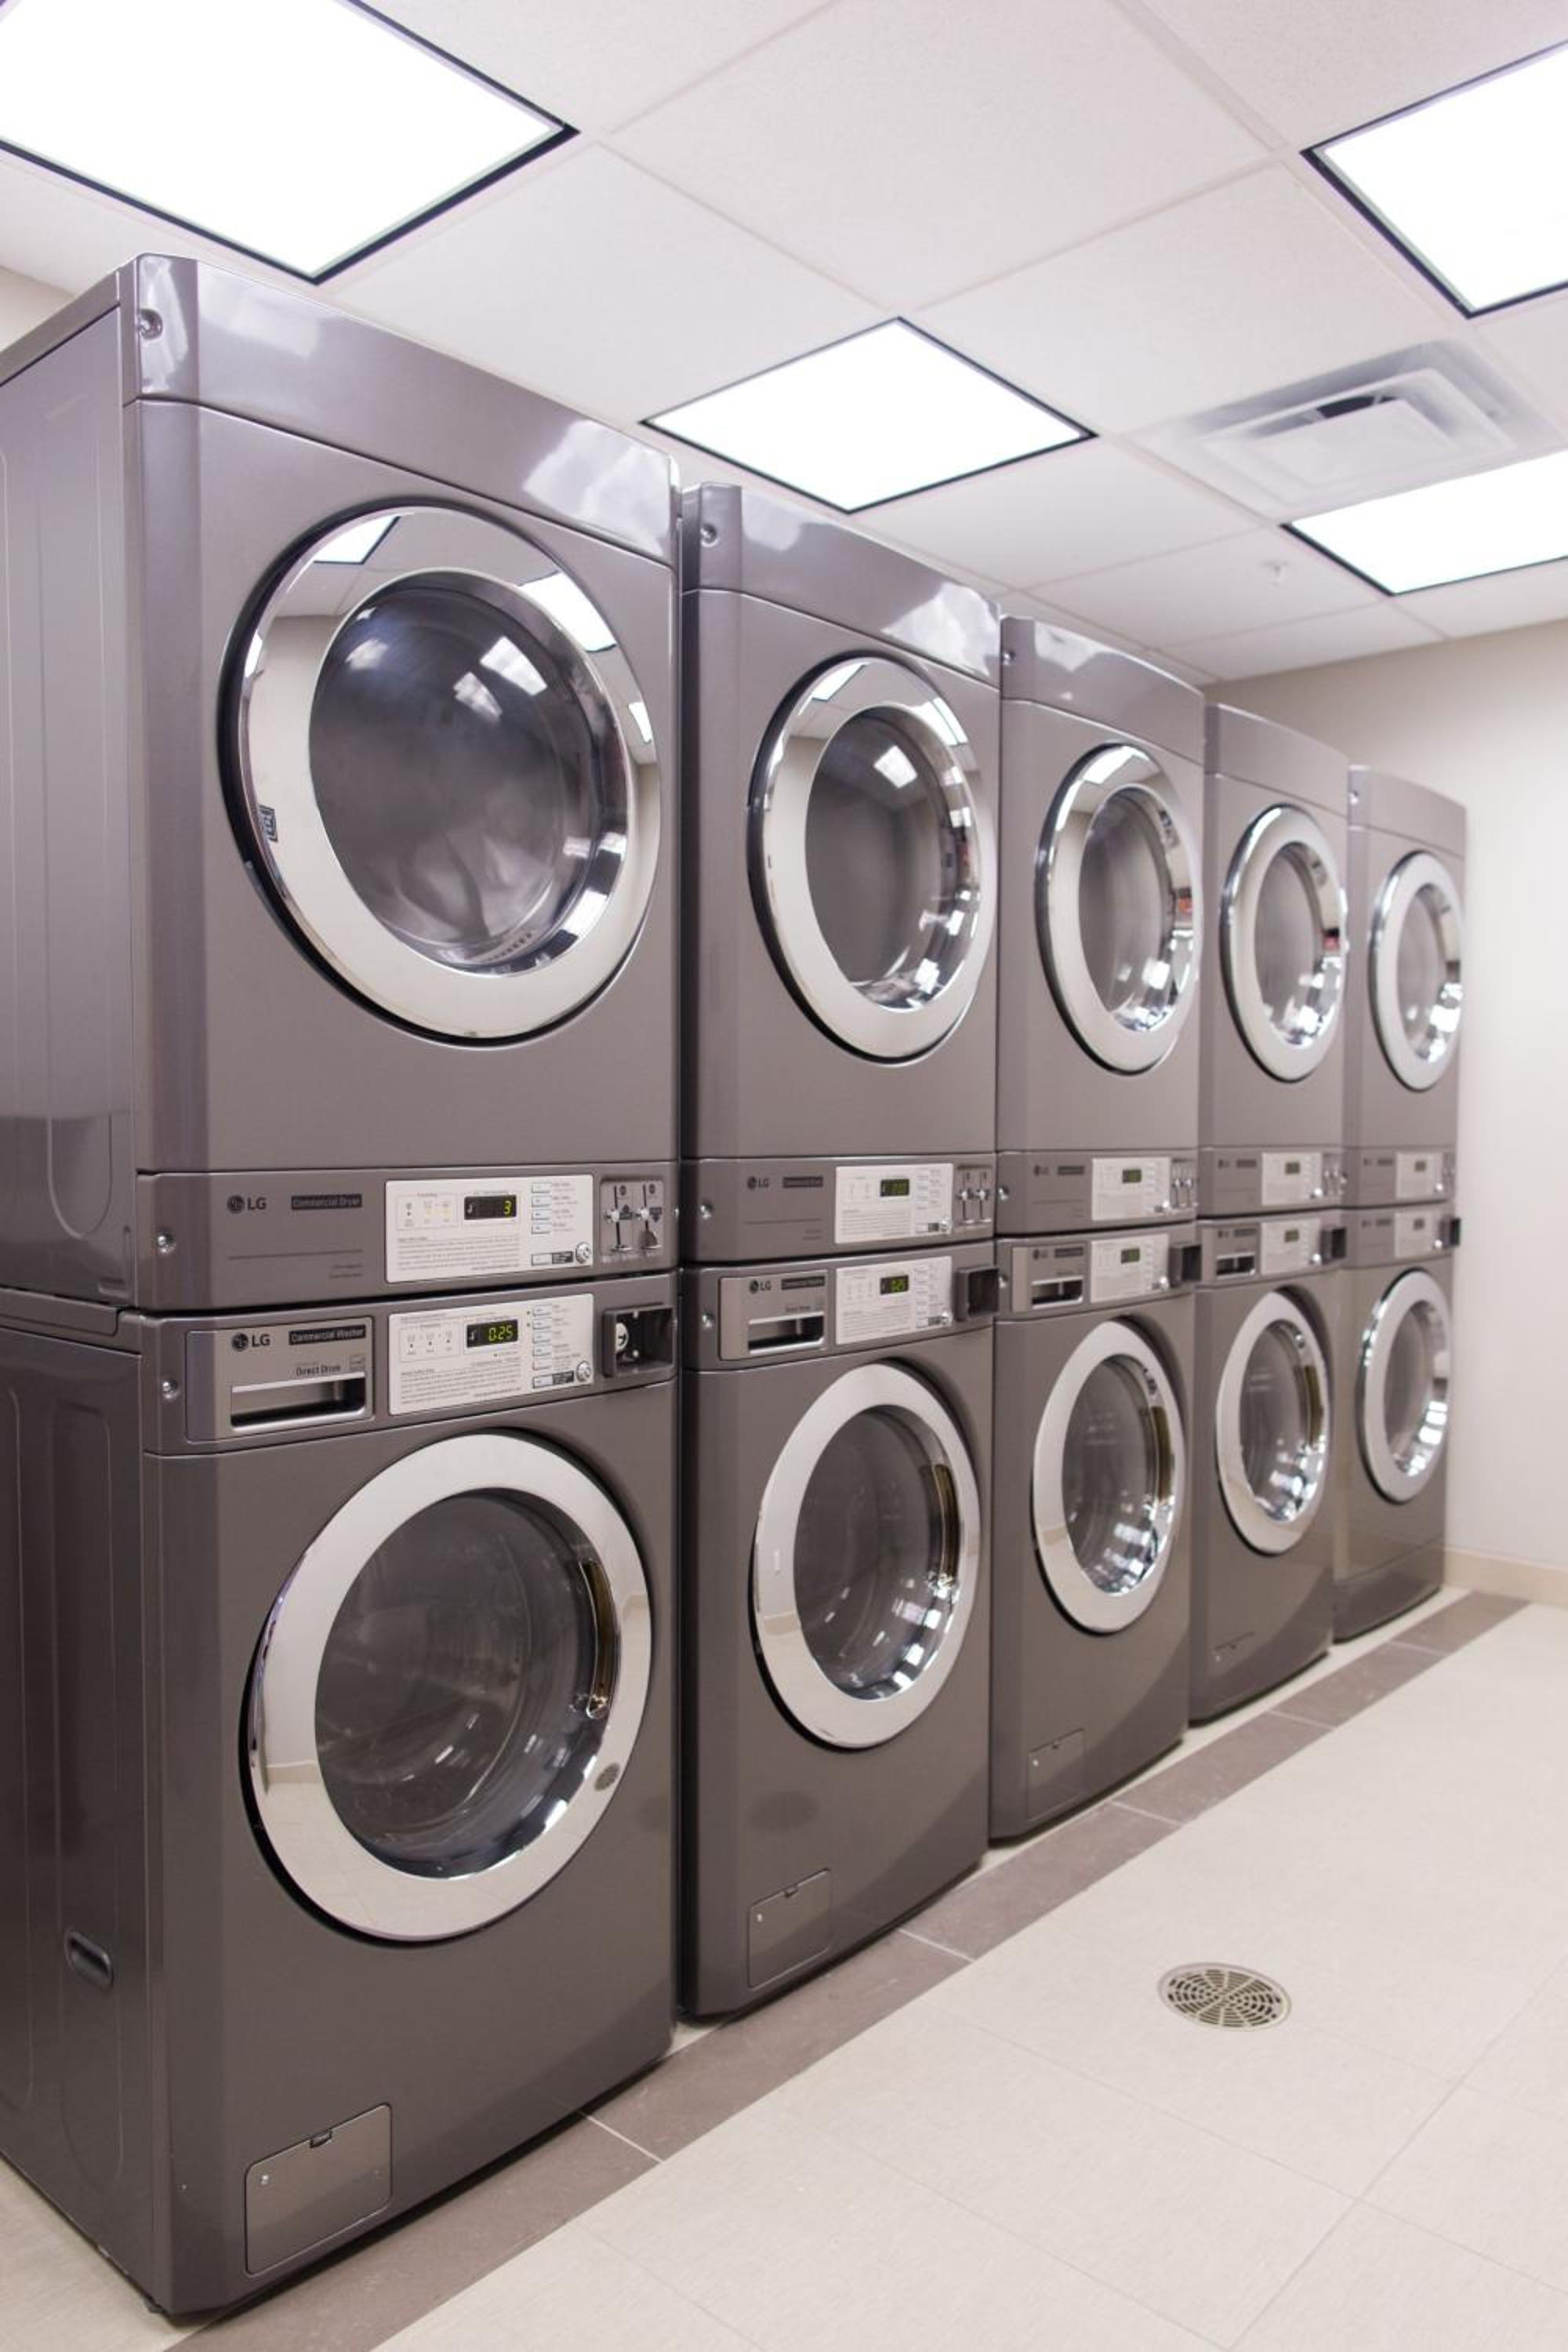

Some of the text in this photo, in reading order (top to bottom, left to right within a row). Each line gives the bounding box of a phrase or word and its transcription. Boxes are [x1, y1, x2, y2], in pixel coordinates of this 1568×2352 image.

[247, 1197, 267, 1210] LG
[503, 1200, 512, 1214] 3
[760, 1280, 772, 1291] LG
[252, 1334, 270, 1347] LG
[291, 1329, 364, 1342] Commercial Washer
[296, 1364, 341, 1376] Direct Drive
